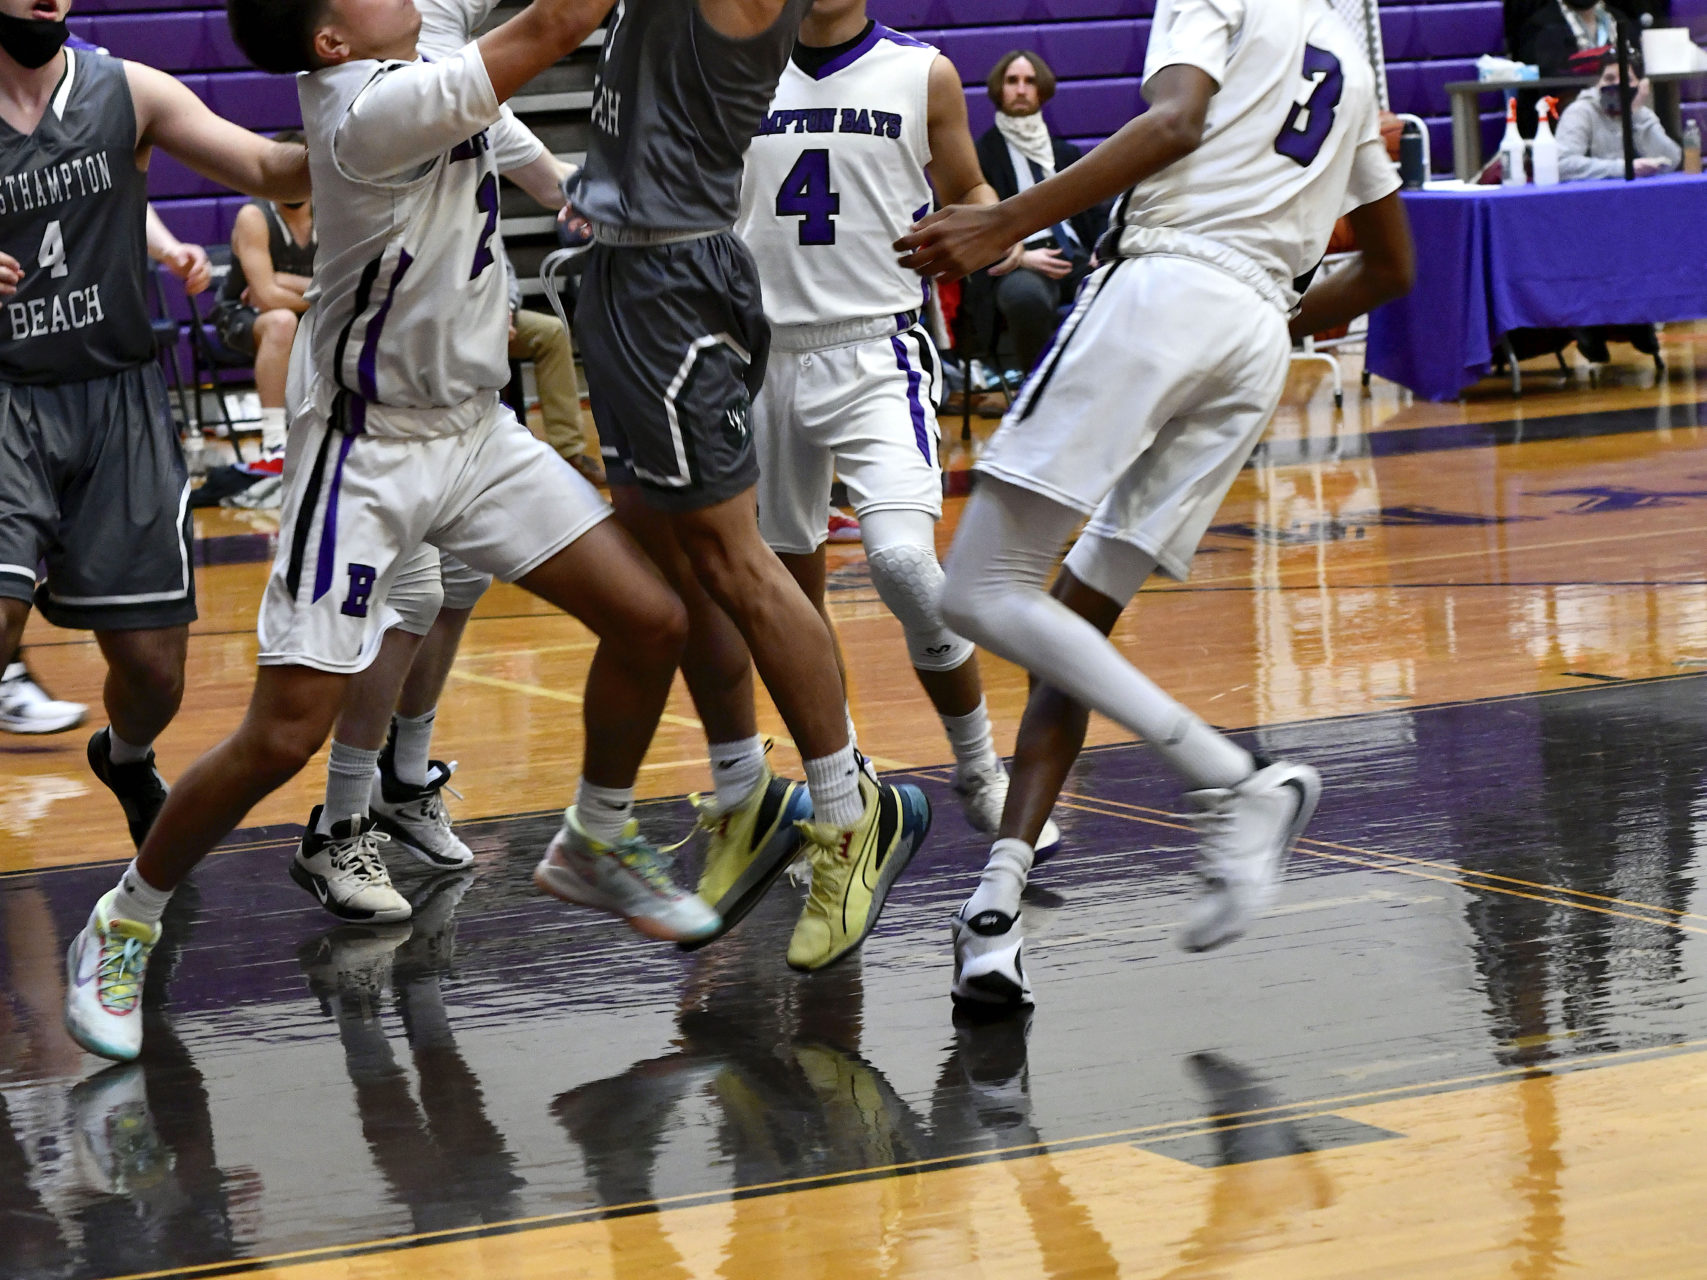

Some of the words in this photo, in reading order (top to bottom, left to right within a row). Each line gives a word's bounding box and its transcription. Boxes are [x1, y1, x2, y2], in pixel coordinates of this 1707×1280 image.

[751, 108, 838, 138] MPTON
[839, 108, 903, 139] BAYS
[1274, 41, 1344, 168] 3
[468, 170, 499, 281] 2
[775, 148, 840, 246] 4
[38, 219, 69, 279] 4
[8, 283, 104, 340] BEACH
